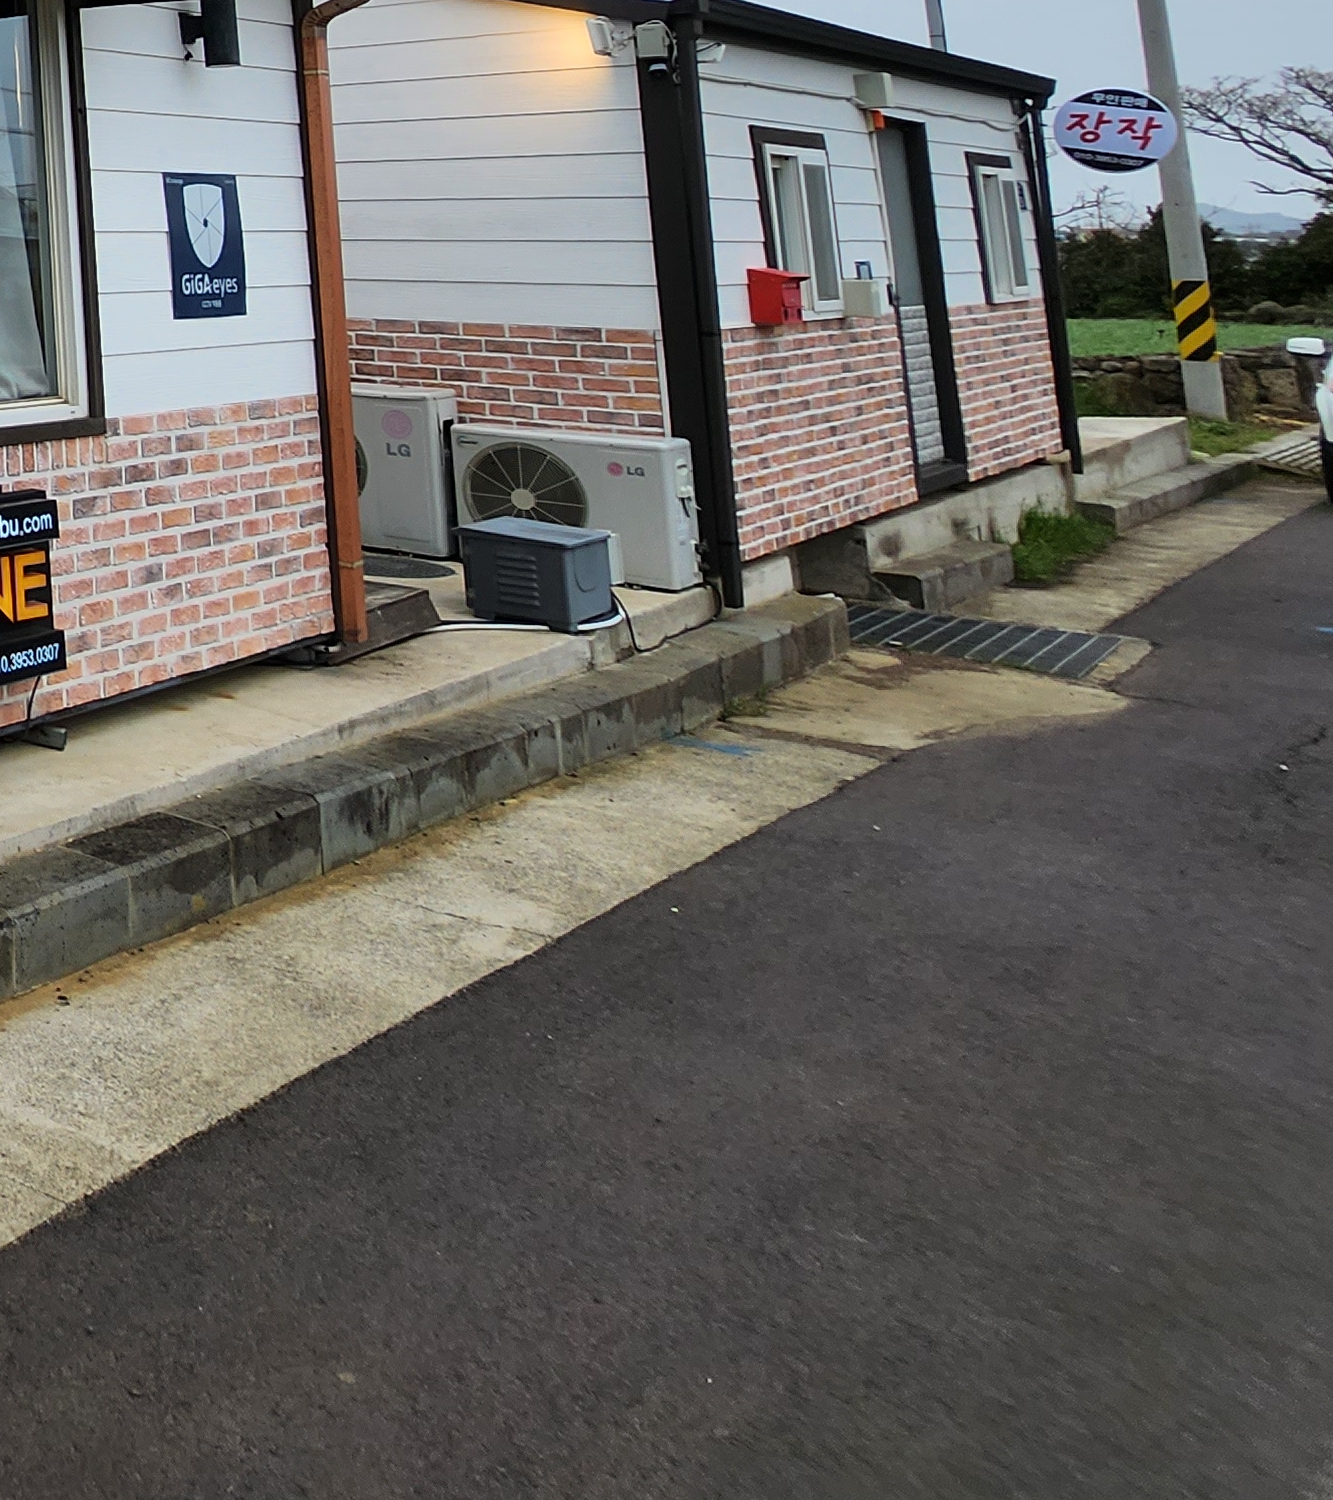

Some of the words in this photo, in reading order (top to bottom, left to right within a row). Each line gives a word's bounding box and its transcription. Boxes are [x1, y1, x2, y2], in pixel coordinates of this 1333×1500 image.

[1091, 92, 1149, 109] 무인판매
[1065, 110, 1164, 151] 장작
[385, 442, 412, 458] LG
[626, 465, 646, 477] LG
